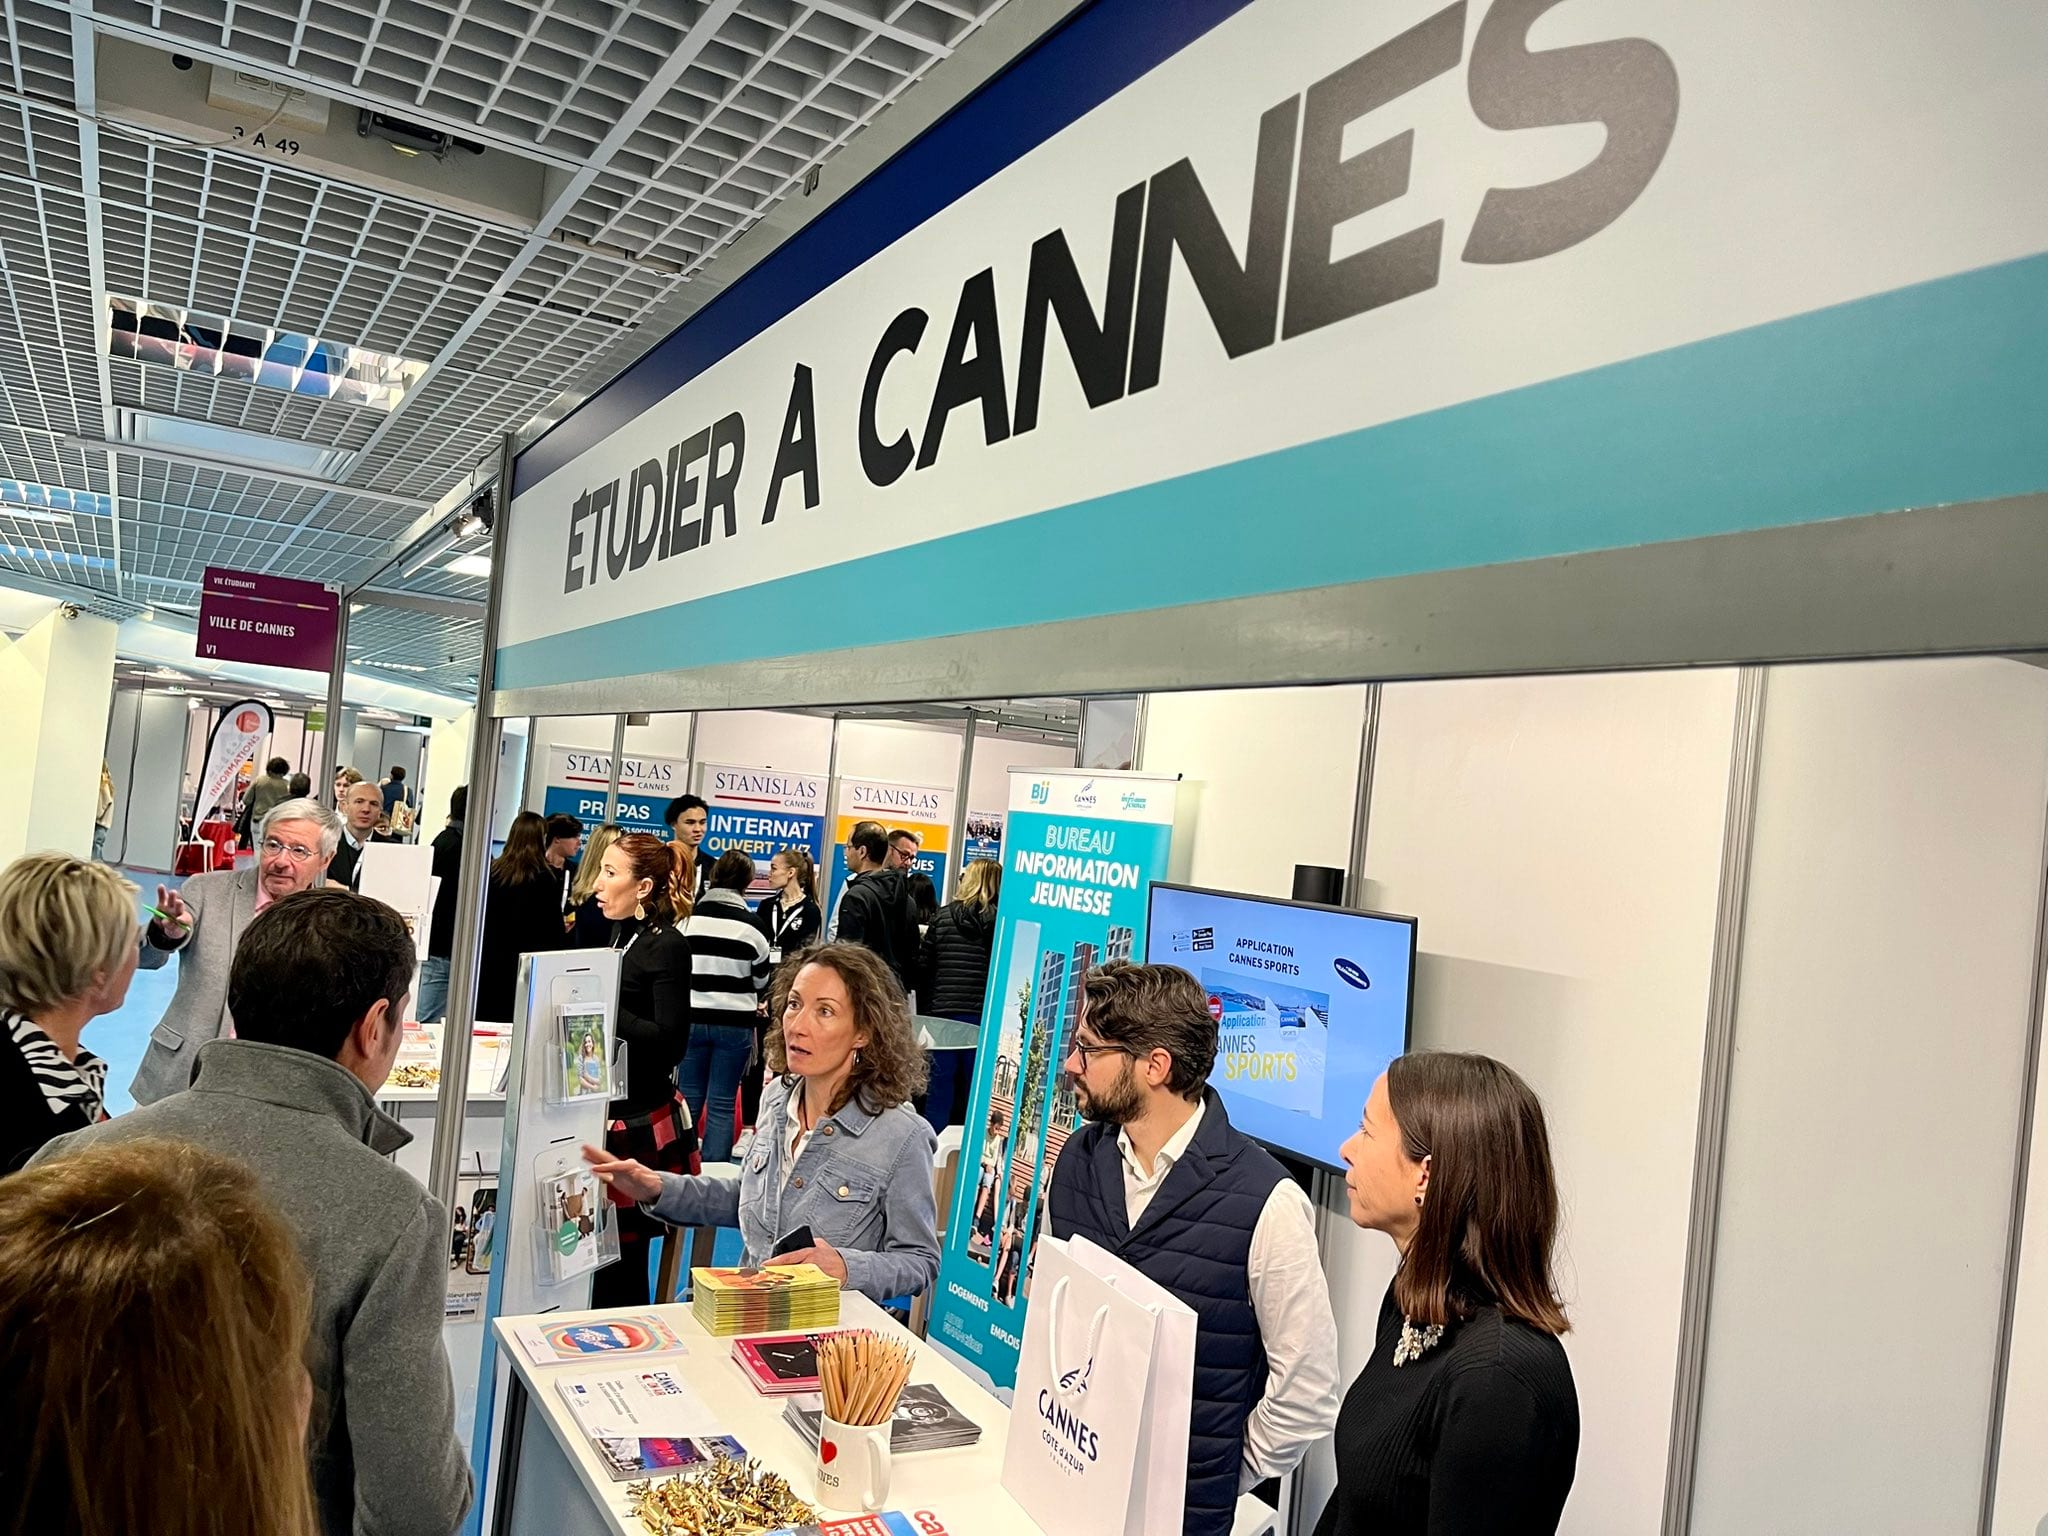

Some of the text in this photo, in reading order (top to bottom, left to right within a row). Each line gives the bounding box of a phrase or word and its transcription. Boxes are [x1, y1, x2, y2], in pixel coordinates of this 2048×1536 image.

[252, 132, 266, 149] A
[275, 138, 300, 156] 49
[564, 411, 746, 595] ÉTUDIER
[858, 0, 1681, 488] CANNES
[213, 577, 256, 590] VIE ÉTUDIANTE
[209, 615, 296, 637] VILLE DE CANNES
[206, 643, 217, 655] V1
[209, 734, 261, 797] INFORMATIONS
[637, 782, 670, 792] CANNES
[715, 772, 817, 798] STANISLAS
[578, 799, 651, 820] PRPAS
[784, 800, 815, 809] CANNES
[853, 786, 939, 809] STANISLAS
[710, 814, 814, 839] INTERNAT
[911, 810, 937, 819] CANNES
[707, 836, 775, 855] OUVERT
[1045, 824, 1116, 855] BUREAU
[1014, 849, 1140, 890] INFORMATION
[1029, 880, 1113, 917] JEUNESSE
[1235, 937, 1295, 958] APPLICATION
[1228, 952, 1300, 976] CANNES SPORTS
[1221, 1013, 1267, 1030] Application
[1218, 1034, 1256, 1054] ANNES
[1224, 1051, 1298, 1082] SPORTS
[947, 1280, 990, 1313] LOGEMENTS
[989, 1323, 1021, 1351] EMPLOIS
[1038, 1388, 1099, 1462] CANNES
[1042, 1429, 1059, 1453] CÔTE
